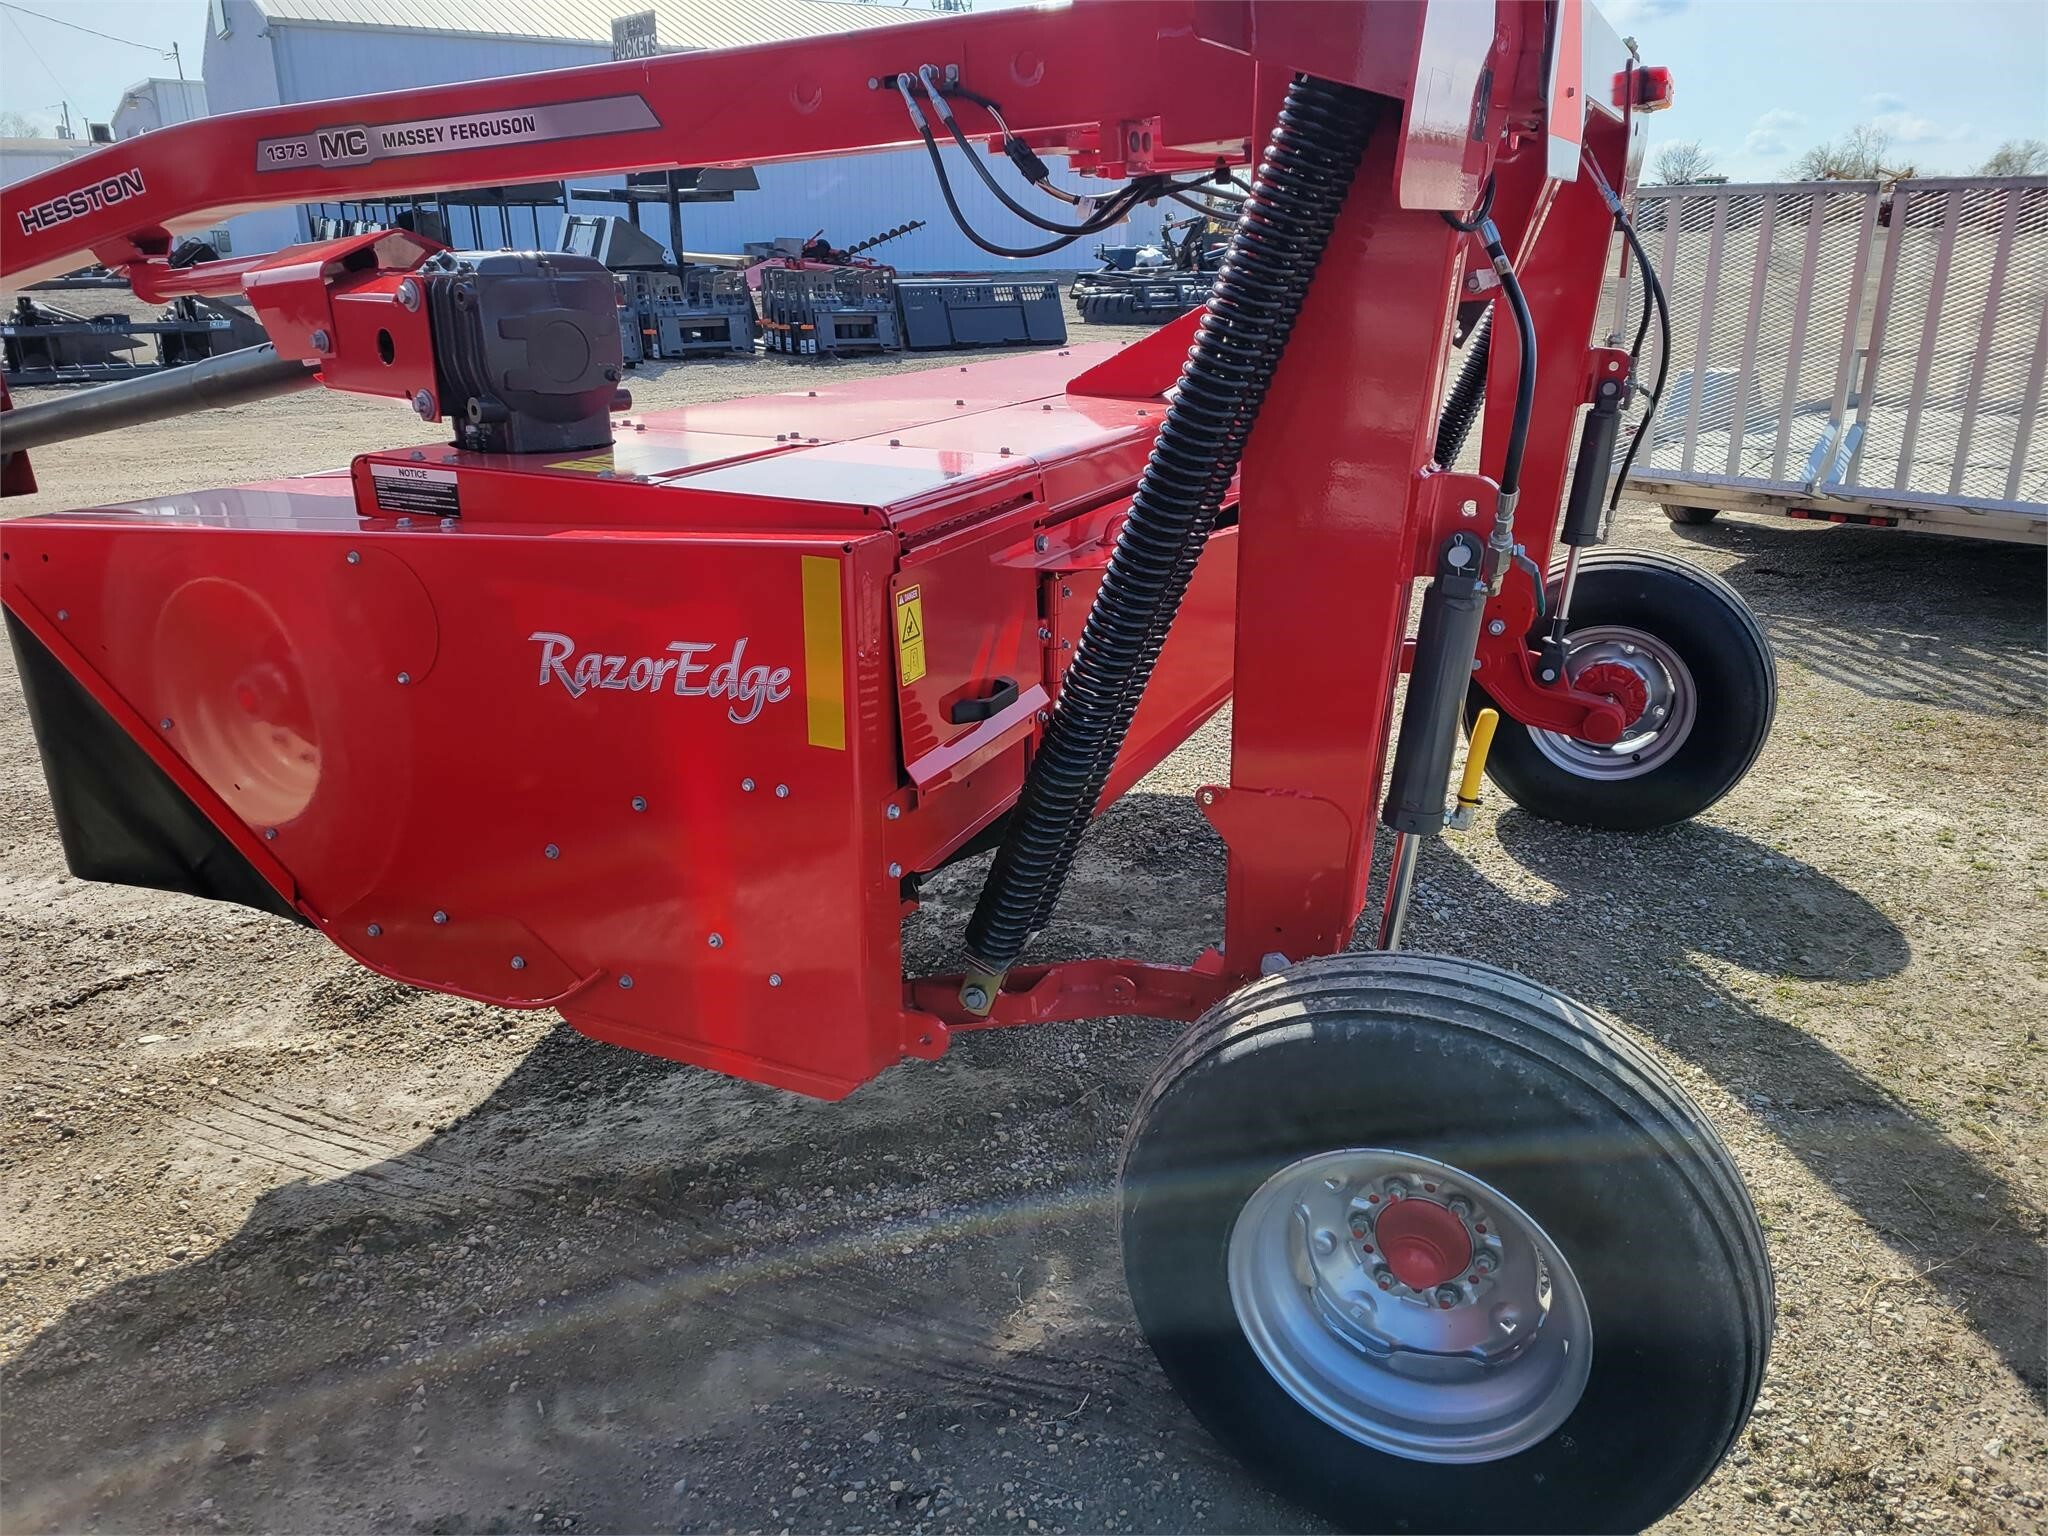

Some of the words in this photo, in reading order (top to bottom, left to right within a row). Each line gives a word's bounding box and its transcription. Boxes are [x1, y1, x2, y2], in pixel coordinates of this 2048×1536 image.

[614, 33, 656, 60] BUCKETS
[266, 143, 308, 161] 1373
[318, 130, 368, 160] MC
[382, 126, 444, 149] MASSEY
[450, 114, 536, 141] FERGUSON
[17, 167, 146, 236] HESSTON
[398, 468, 428, 479] NOTICE
[528, 631, 791, 724] RazorEdge
